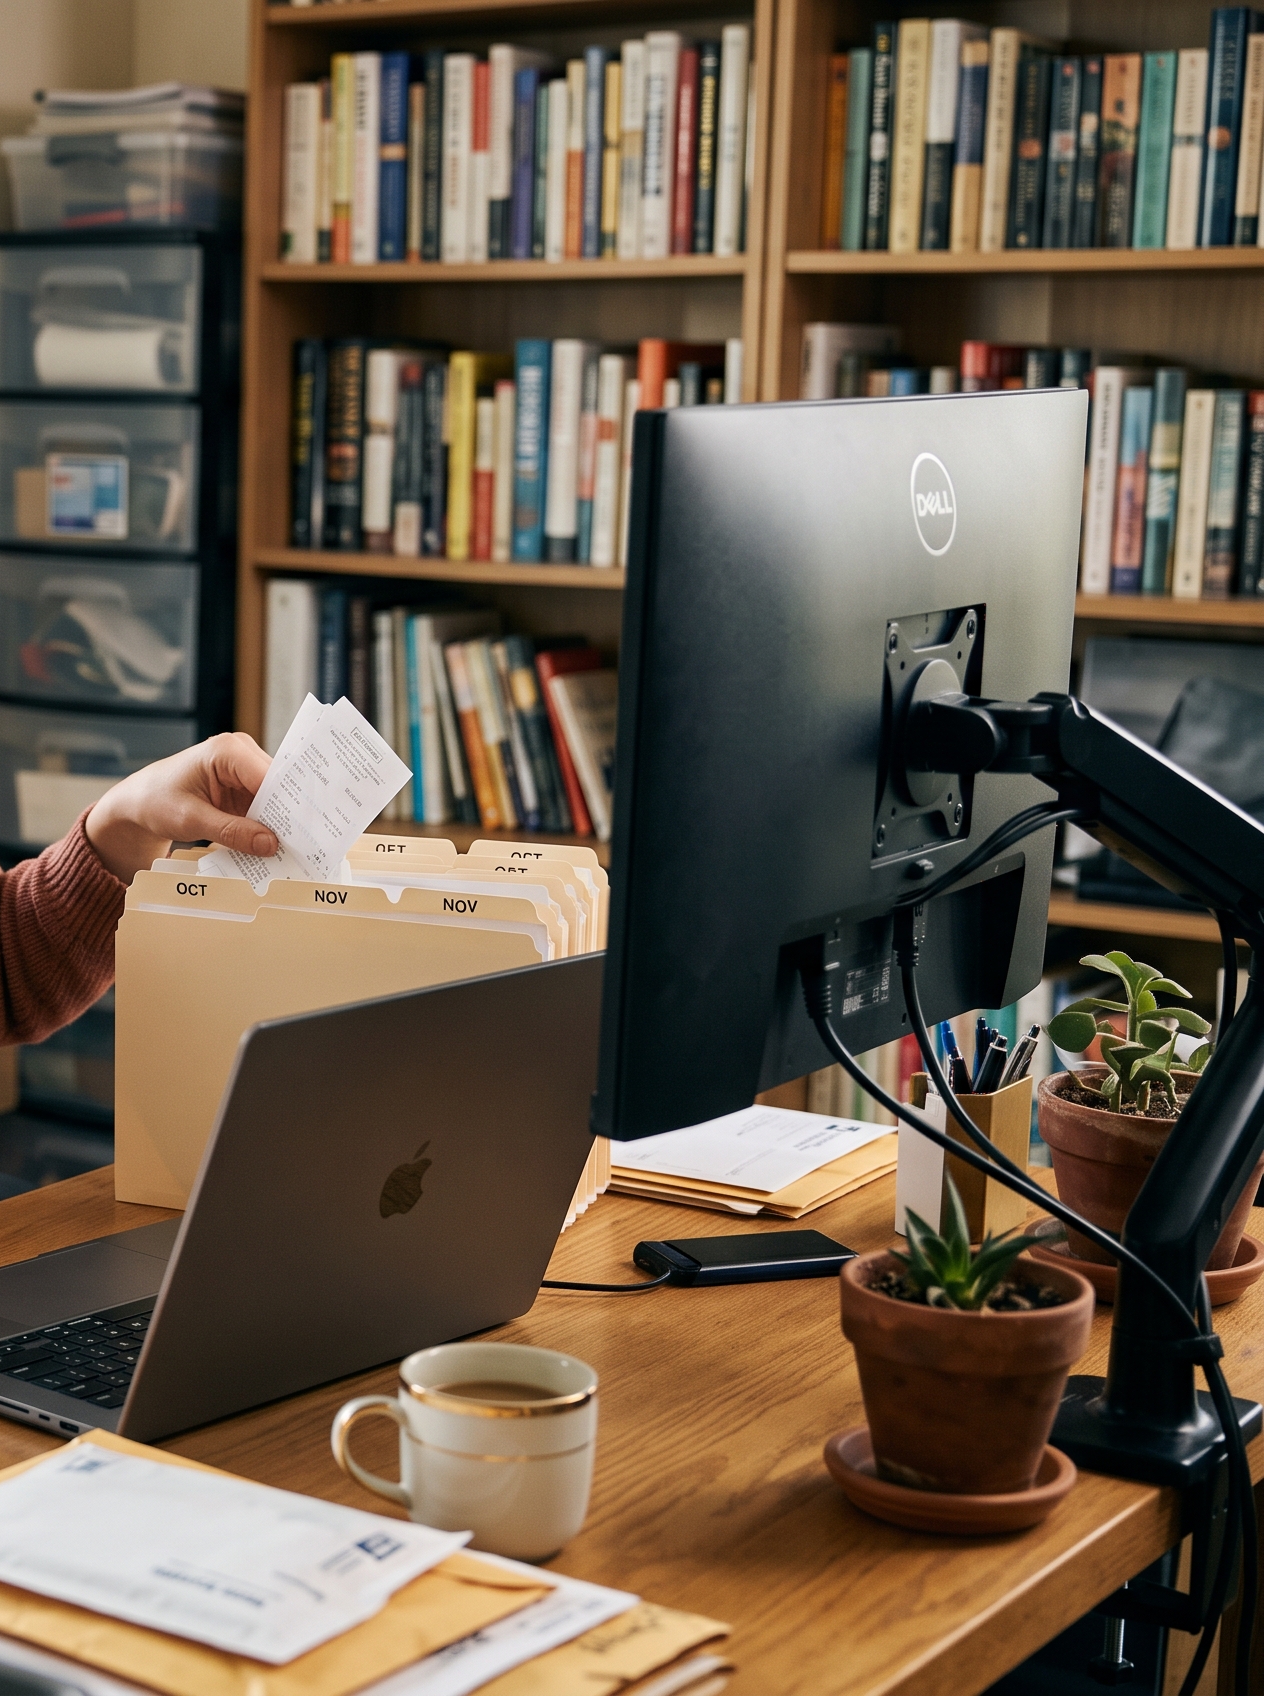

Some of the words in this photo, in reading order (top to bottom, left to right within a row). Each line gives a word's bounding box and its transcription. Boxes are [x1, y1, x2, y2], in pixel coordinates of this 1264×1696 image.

[916, 490, 953, 517] DELL
[176, 882, 208, 897] OCT
[314, 889, 348, 905] NOV
[443, 897, 478, 914] NOV
